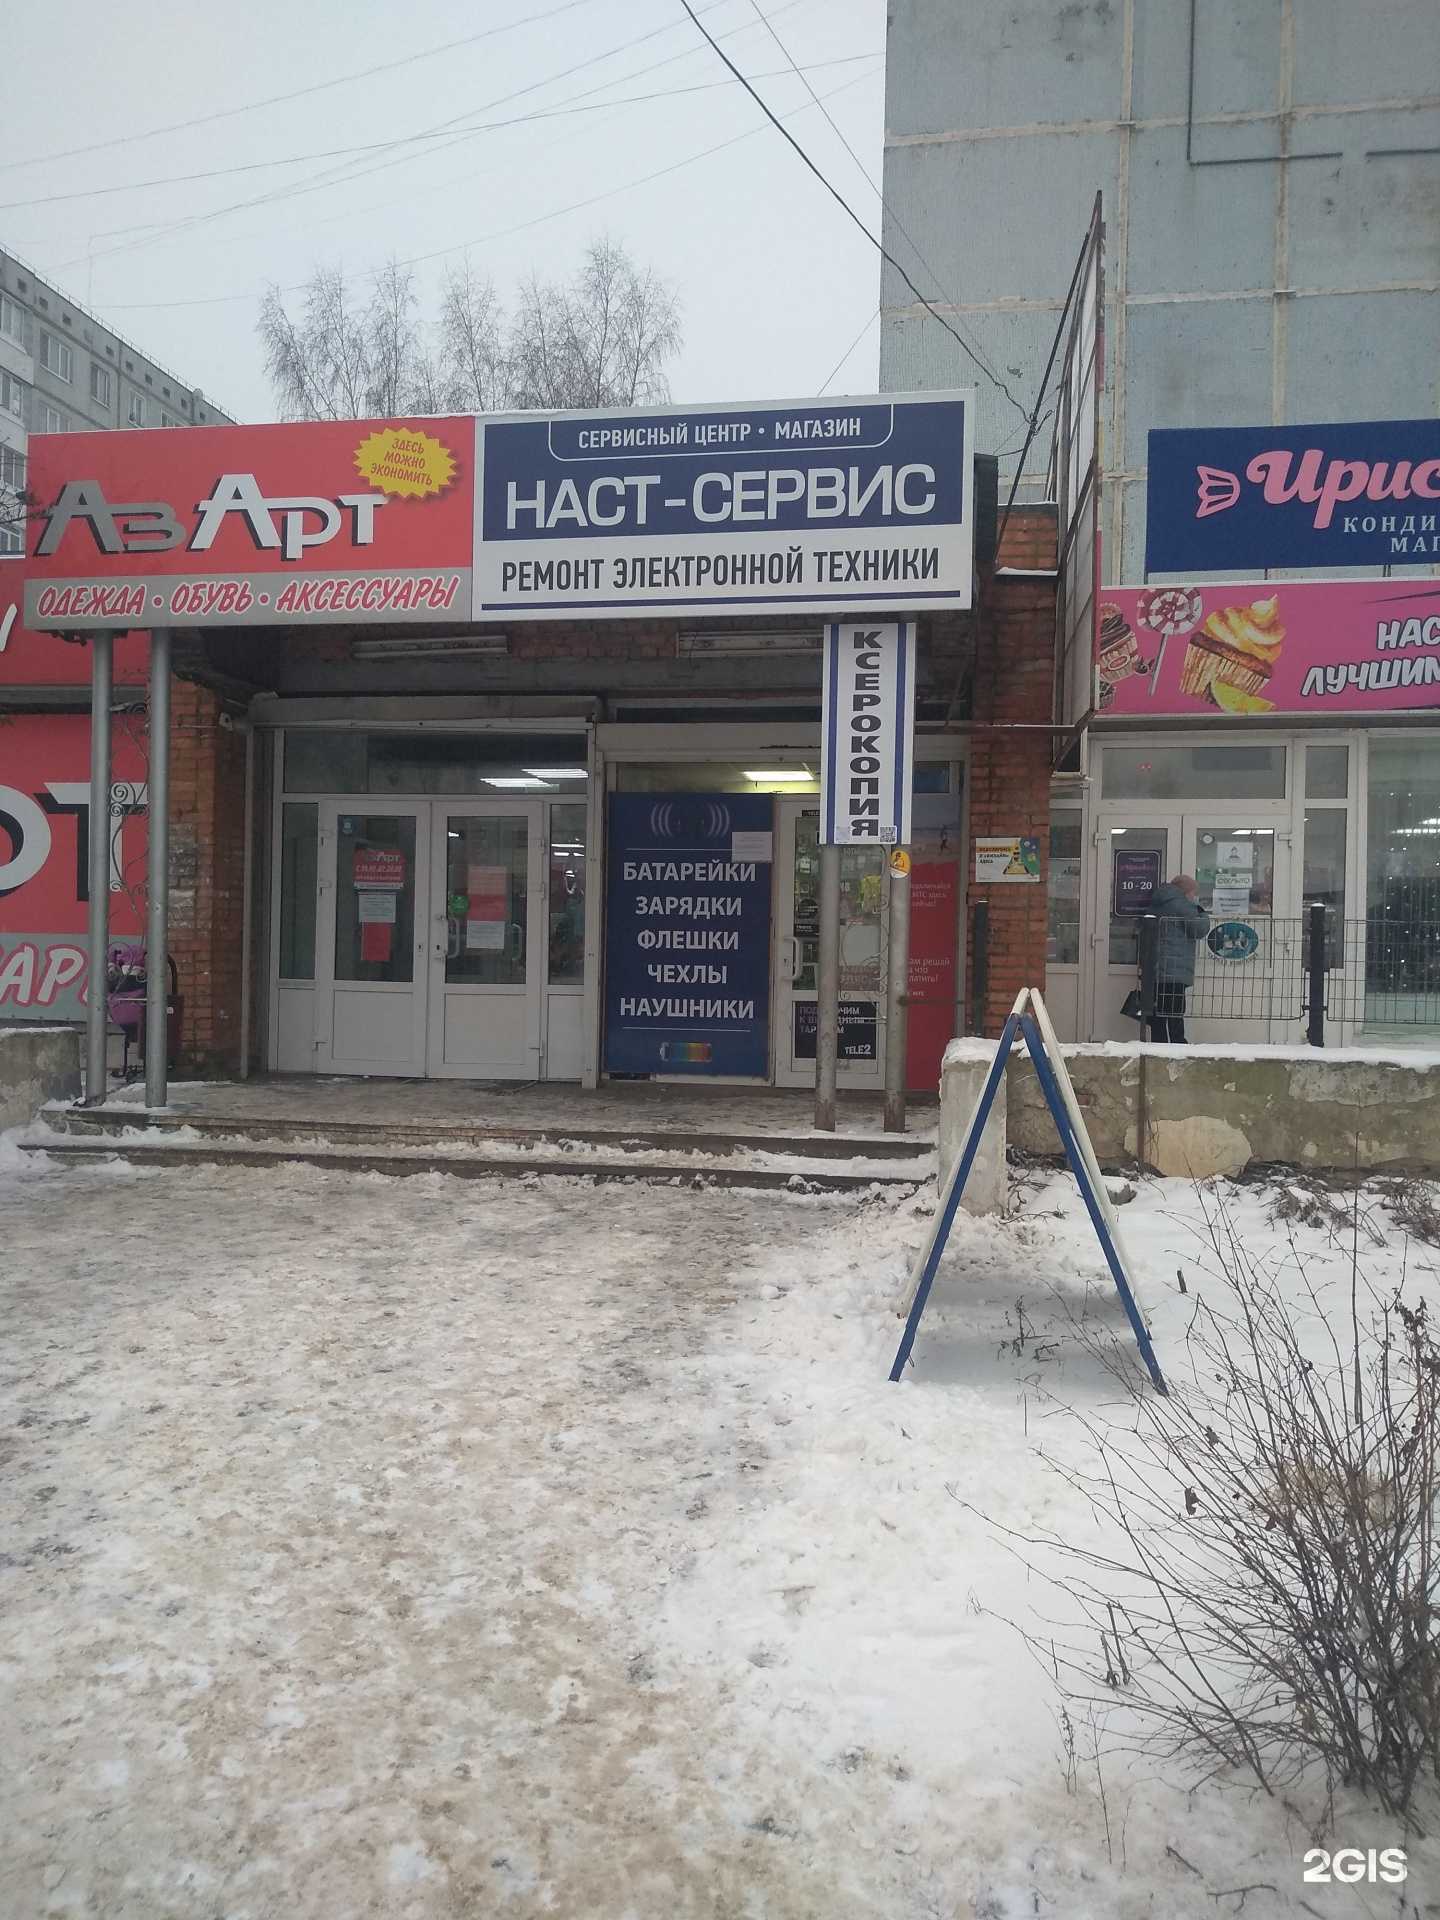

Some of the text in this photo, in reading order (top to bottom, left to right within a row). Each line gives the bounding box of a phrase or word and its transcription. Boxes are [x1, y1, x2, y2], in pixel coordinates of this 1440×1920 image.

[578, 418, 861, 448] СЕРВИСНЫЙ ЦЕНТР МАГАЗИН
[392, 438, 424, 454] ЗДЕСЬ
[384, 451, 426, 470] МОЖНО
[371, 462, 433, 485] ЭКОНОМИТЬ
[1343, 515, 1435, 535] КОНДИ
[502, 546, 939, 592] РЕМОНТ ЭЛЕКТРОННОЙ ТЕХНИКИ
[38, 575, 459, 617] ОДЕЖДА ОБУВЬ АКСЕССУАРЫ
[850, 631, 883, 837] КСЕРОКОПИЯ
[623, 859, 756, 882] БАТАРЕЙКИ
[635, 896, 742, 919] ЗАРЯДКИ
[637, 929, 739, 950] ФЛЕШКИ
[647, 965, 728, 984] ЧЕХЛЫ
[620, 998, 754, 1019] НАУШНИКИ
[845, 1044, 872, 1055] TELE2
